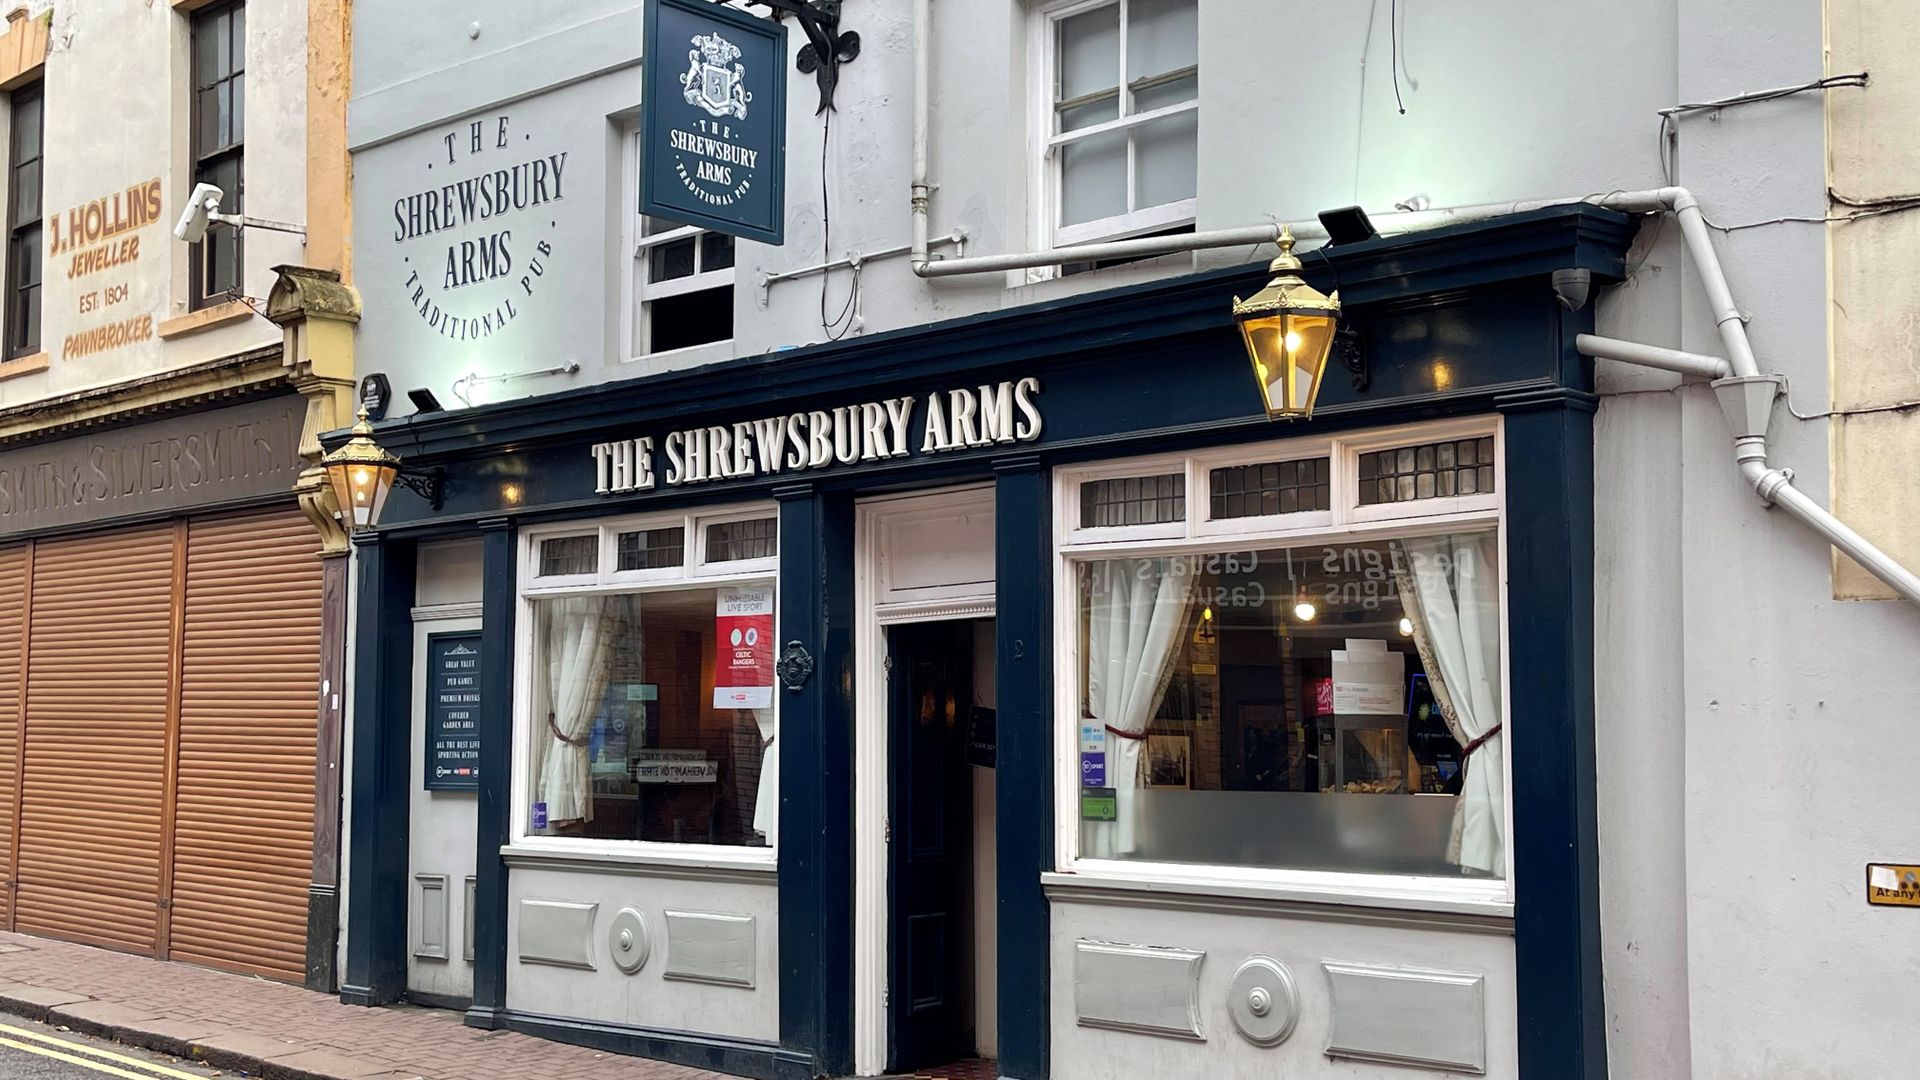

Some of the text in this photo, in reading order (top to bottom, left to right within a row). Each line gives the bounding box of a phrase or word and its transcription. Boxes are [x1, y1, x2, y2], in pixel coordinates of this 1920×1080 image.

[444, 116, 509, 164] THE
[699, 119, 731, 139] THE
[670, 129, 758, 169] SHREWSBURY
[676, 162, 750, 206] TRADITIONAL PUB
[696, 160, 732, 186] ARMS
[394, 151, 568, 243] SHREWSBURY
[66, 235, 140, 281] JEWELLER
[443, 230, 512, 290] ARMS
[104, 282, 128, 306] 1804
[405, 239, 552, 341] TRADITIONAL PUB
[62, 313, 153, 361] PAWNBROKER
[591, 377, 1042, 495] THE SHREWSBURY ARMS
[727, 602, 763, 613] LIVE SPORT
[445, 660, 459, 669] GREAT
[447, 677, 473, 686] PUB GAMES
[440, 694, 462, 703] PREMIUM
[442, 720, 461, 729] GARDEN
[448, 711, 469, 719] COVERED
[437, 750, 479, 759] SPORTING ACTION
[1876, 887, 1891, 897] At
[1893, 890, 1915, 900] any
